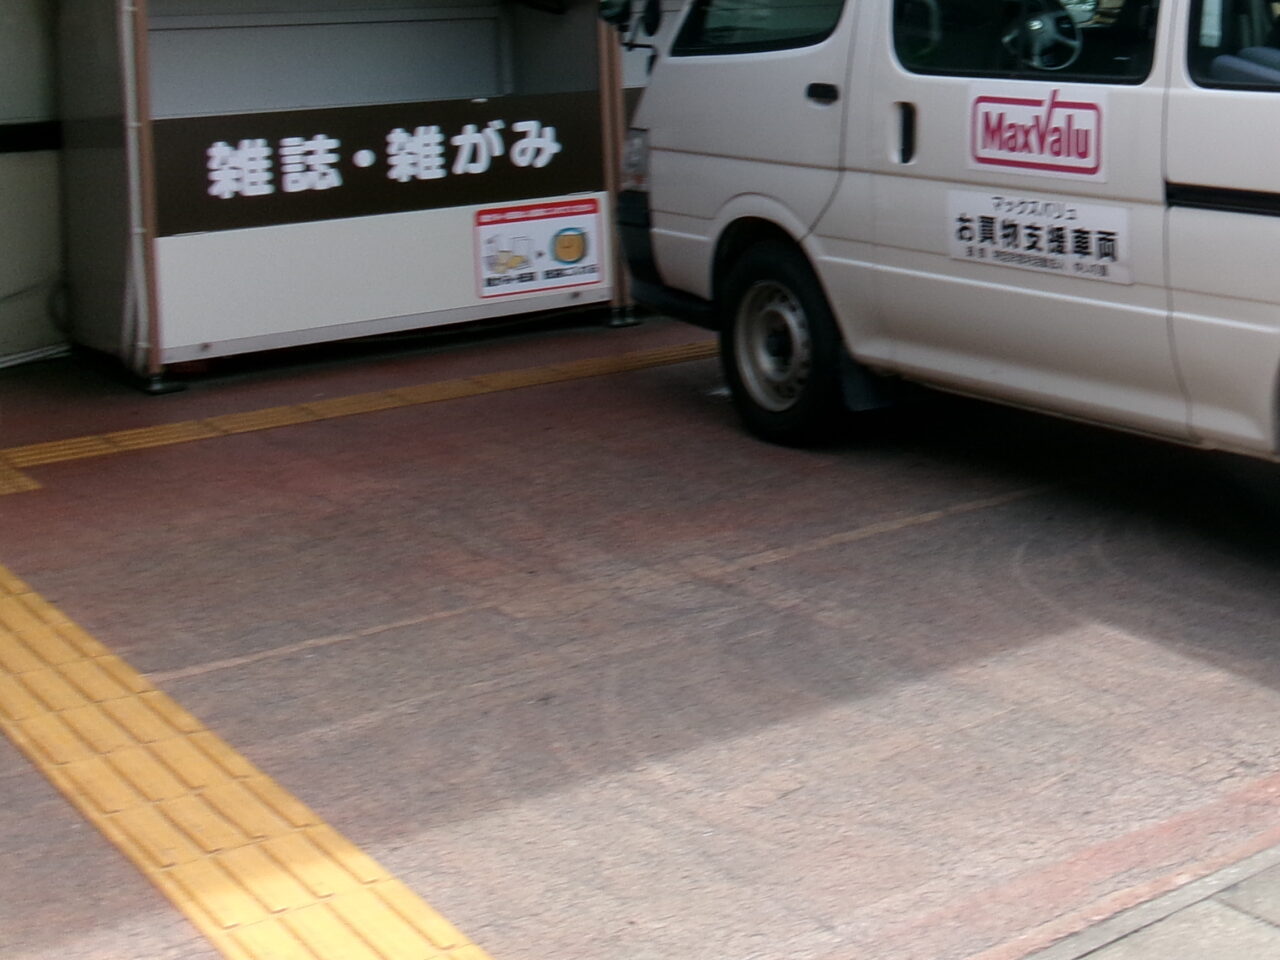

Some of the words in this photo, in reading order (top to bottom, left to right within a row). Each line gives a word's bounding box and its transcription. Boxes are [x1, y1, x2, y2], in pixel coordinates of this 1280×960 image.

[206, 118, 562, 199] 雑誌・雑がみ
[982, 88, 1091, 160] MaxValu
